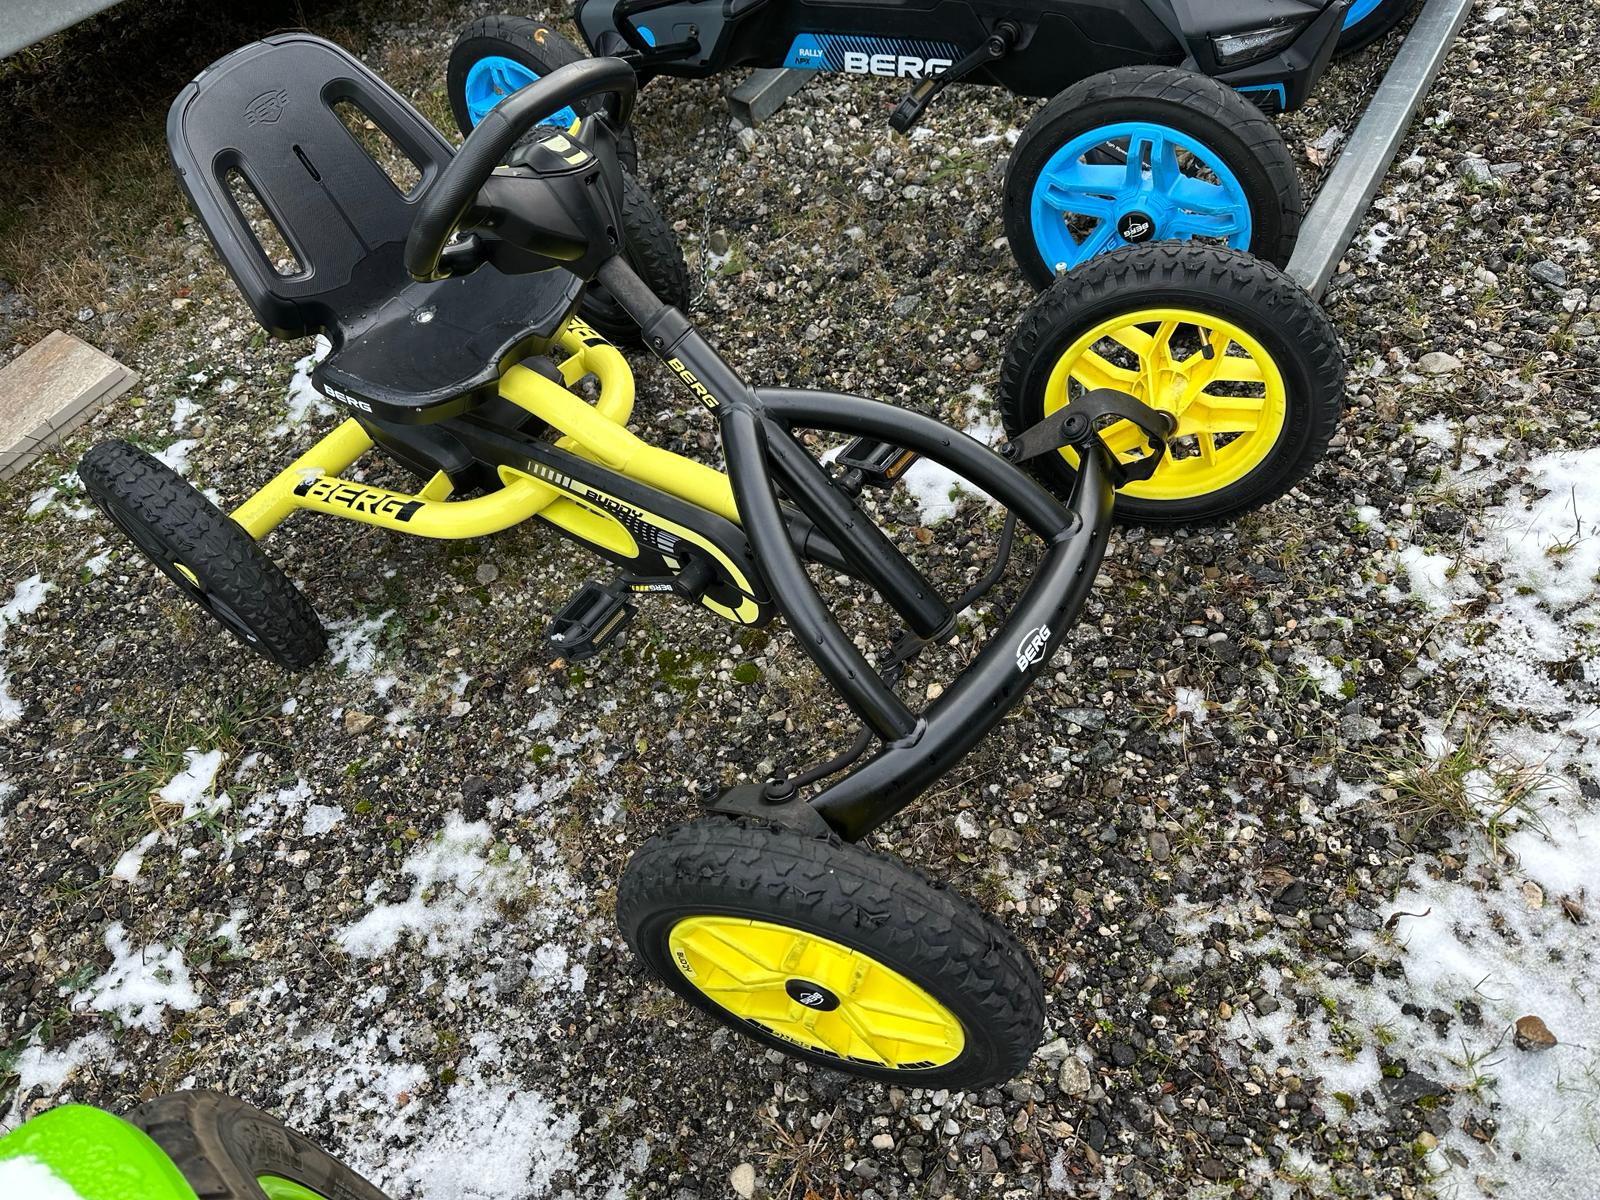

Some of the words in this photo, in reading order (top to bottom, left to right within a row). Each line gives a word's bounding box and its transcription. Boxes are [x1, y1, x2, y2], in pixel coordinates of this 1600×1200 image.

[799, 48, 823, 58] RALLY
[844, 51, 952, 79] BERG
[1123, 222, 1149, 238] BERG
[667, 357, 720, 408] BERG
[323, 383, 373, 413] BERG
[307, 480, 402, 519] BERG
[585, 489, 643, 518] BUDDY
[1016, 623, 1052, 673] BERG
